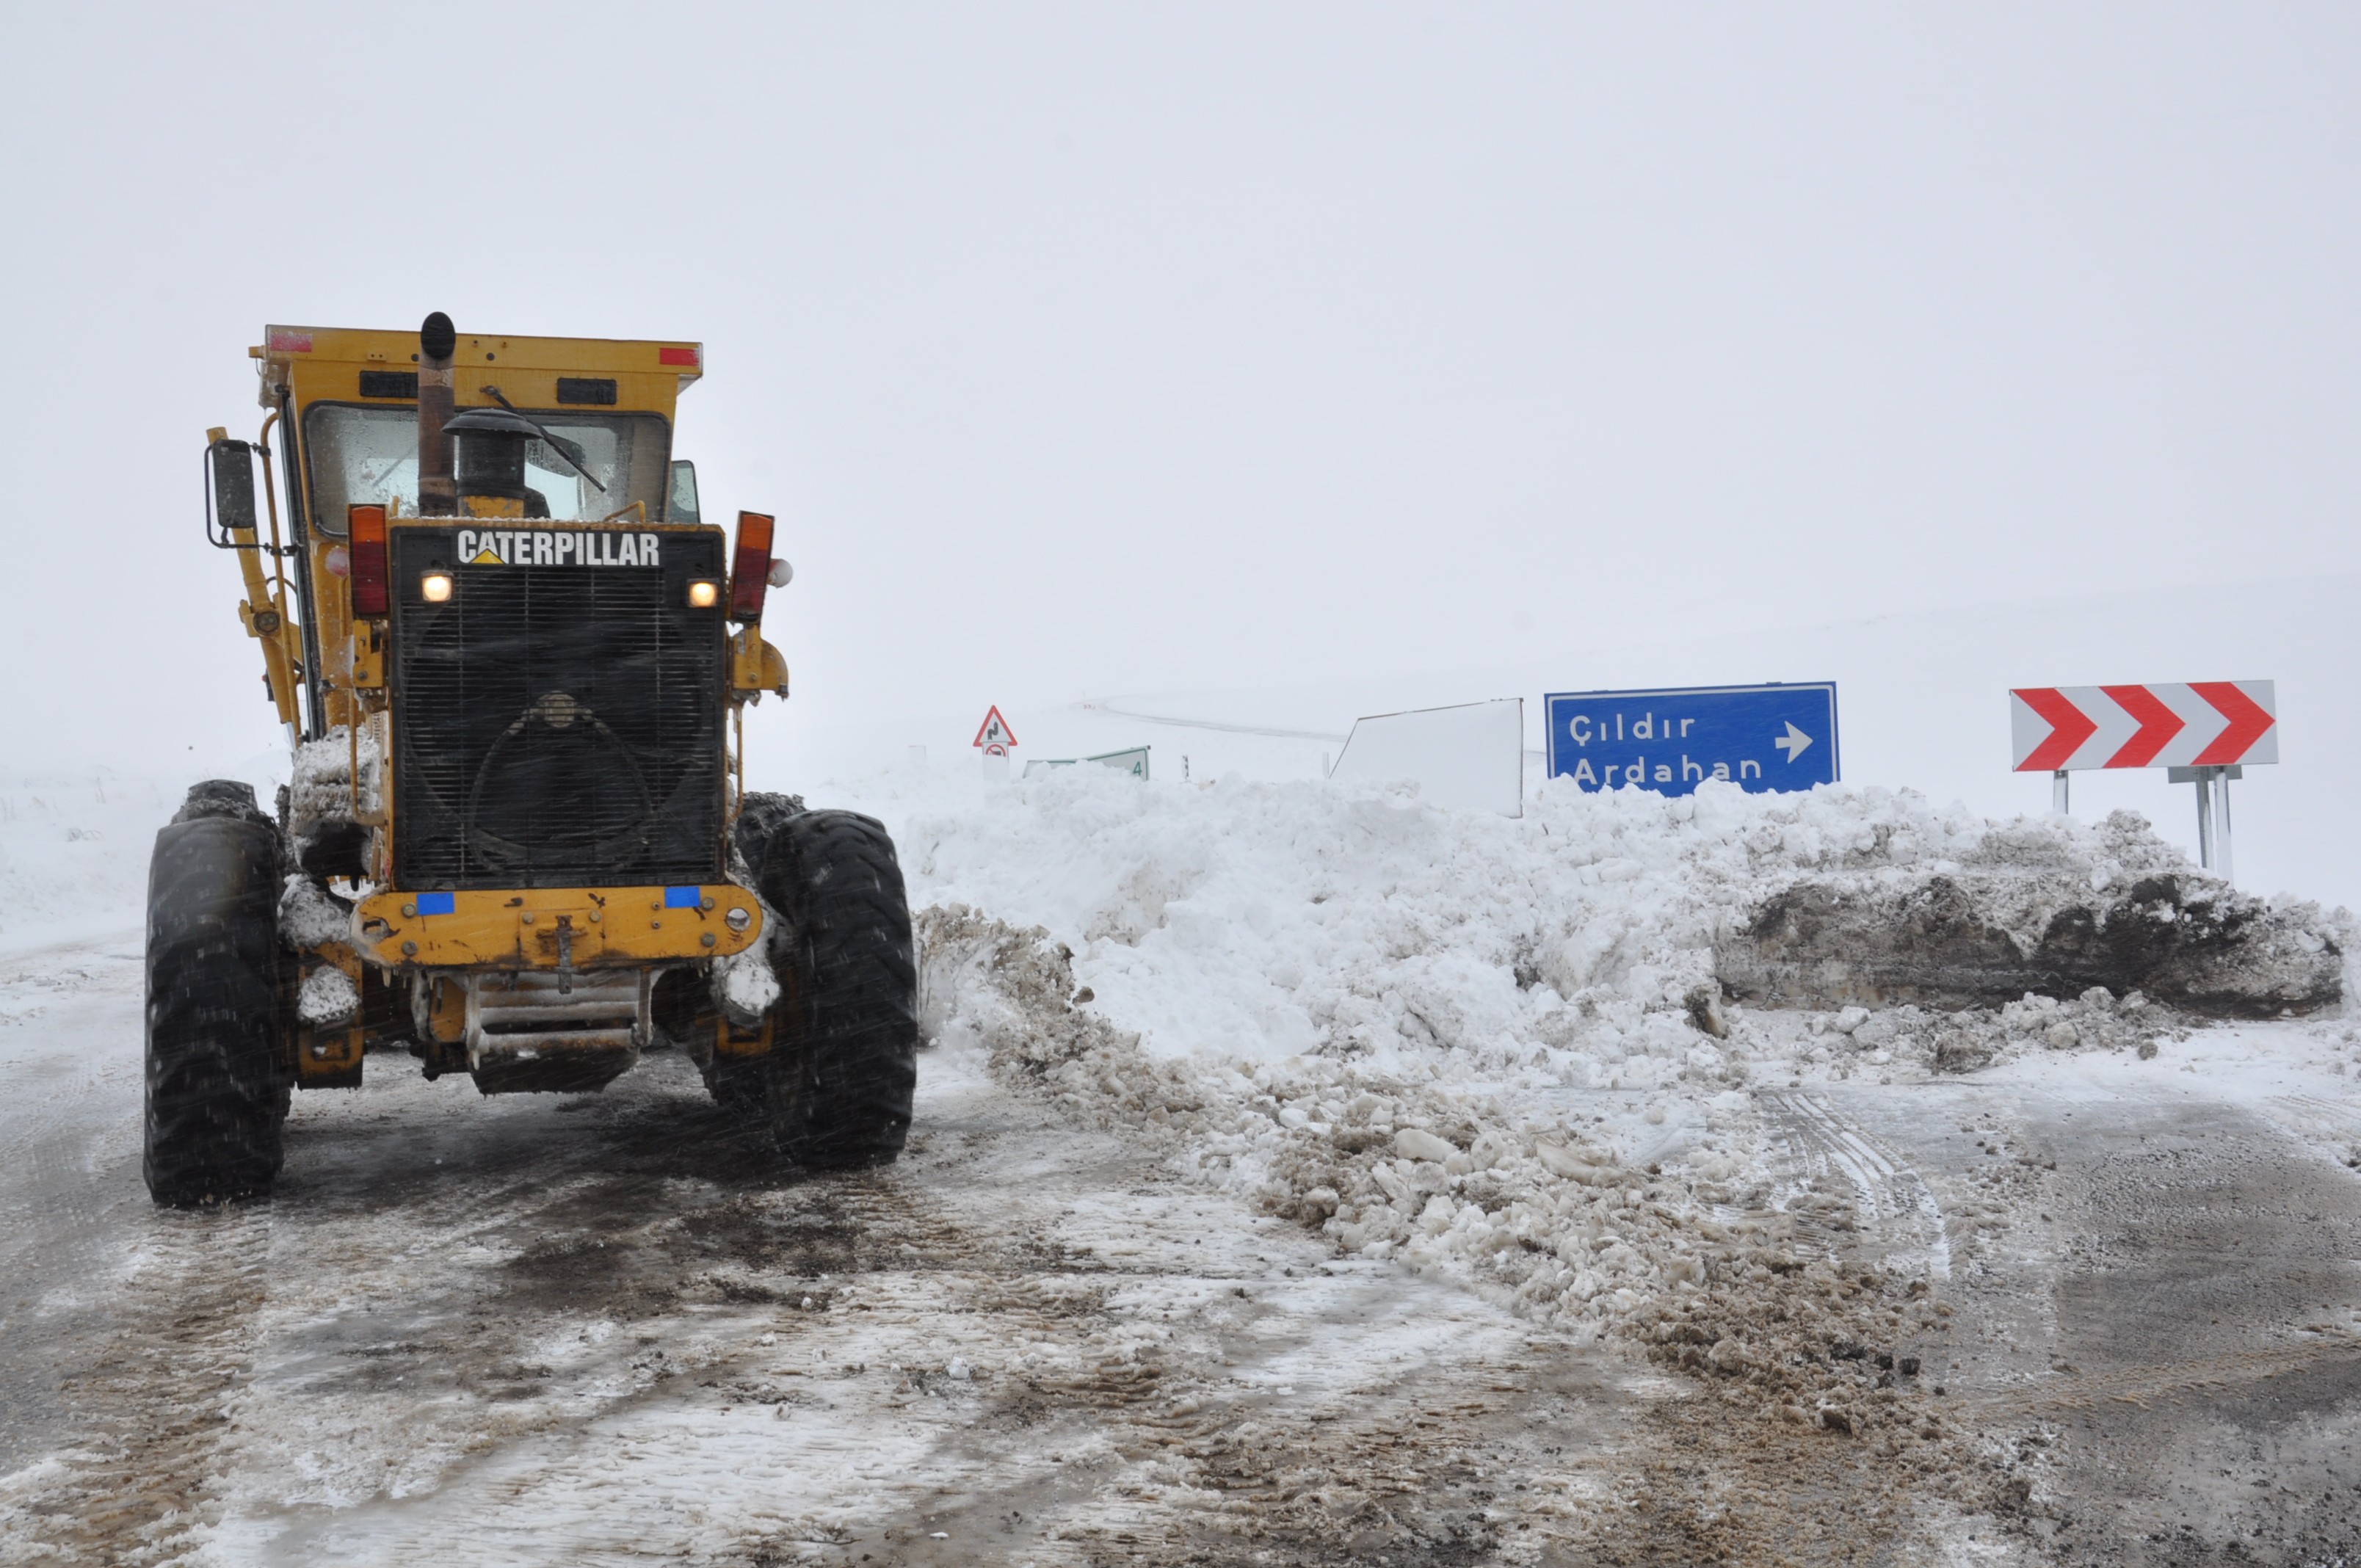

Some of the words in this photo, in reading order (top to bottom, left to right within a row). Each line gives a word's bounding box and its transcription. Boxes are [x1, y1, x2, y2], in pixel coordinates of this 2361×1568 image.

[457, 529, 660, 566] CATERPILLAR
[1570, 712, 1695, 747] Çıldır
[1575, 755, 1761, 785] Ardahan
